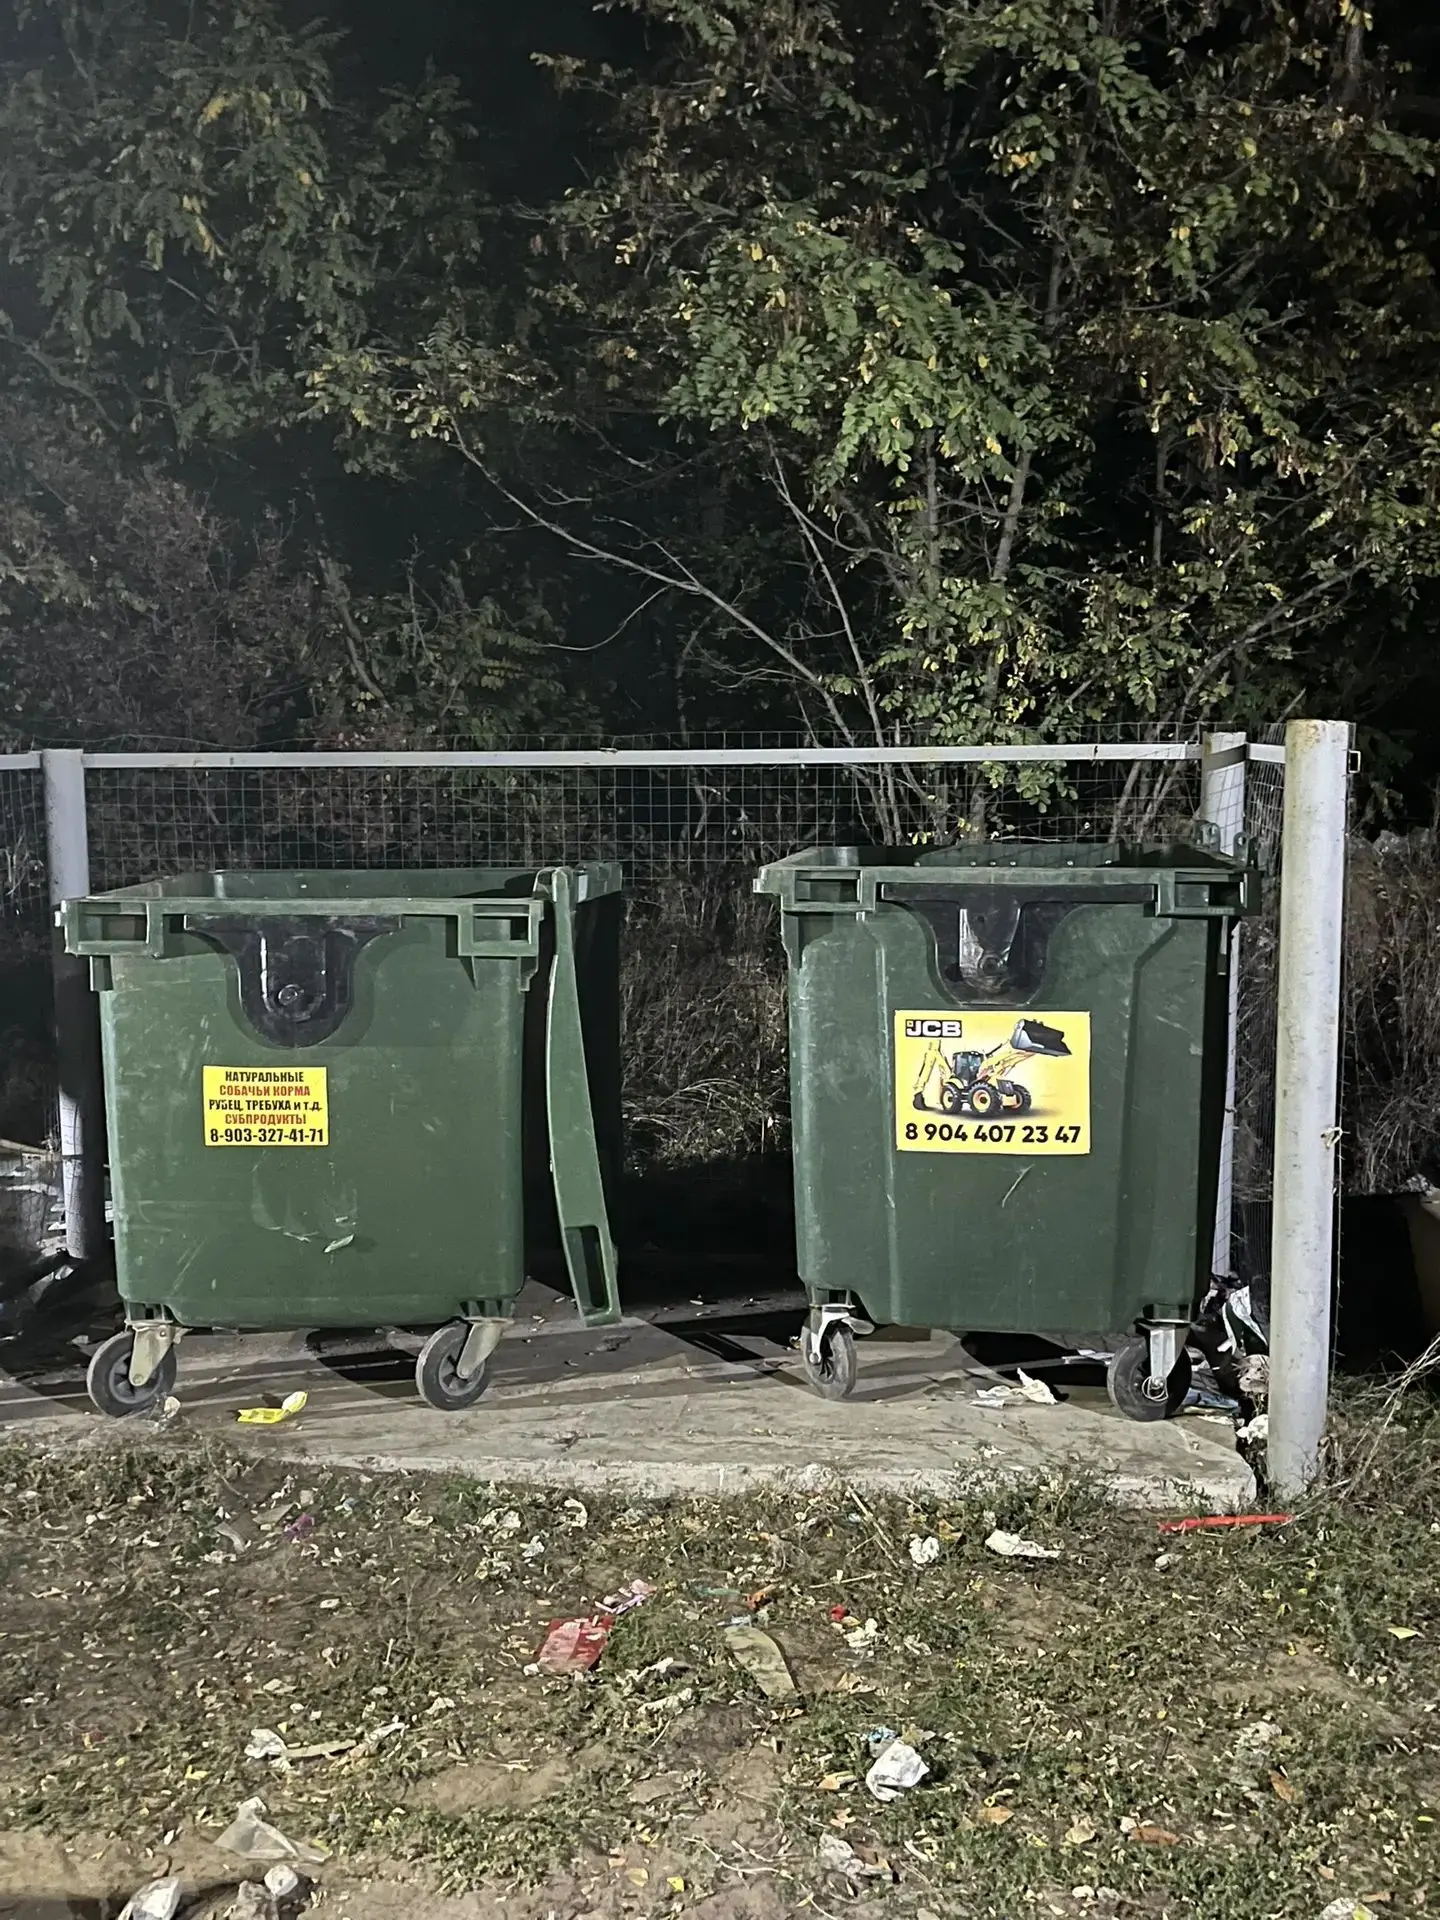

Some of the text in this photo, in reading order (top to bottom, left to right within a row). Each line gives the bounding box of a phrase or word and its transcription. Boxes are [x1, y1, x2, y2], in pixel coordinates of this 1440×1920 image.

[907, 1020, 961, 1037] JCB
[225, 1071, 304, 1082] НАТУРАЛЬНЫЕ
[219, 1085, 310, 1096] СОБАЧЬИ КОРМА
[246, 1099, 291, 1110] ТРЕБУХА
[294, 1101, 301, 1110] и
[225, 1114, 306, 1125] СУБПРОДУКТЫ
[210, 1128, 323, 1142] 8-903-327-41-71
[905, 1123, 1081, 1143] 8 904 407 23 47
